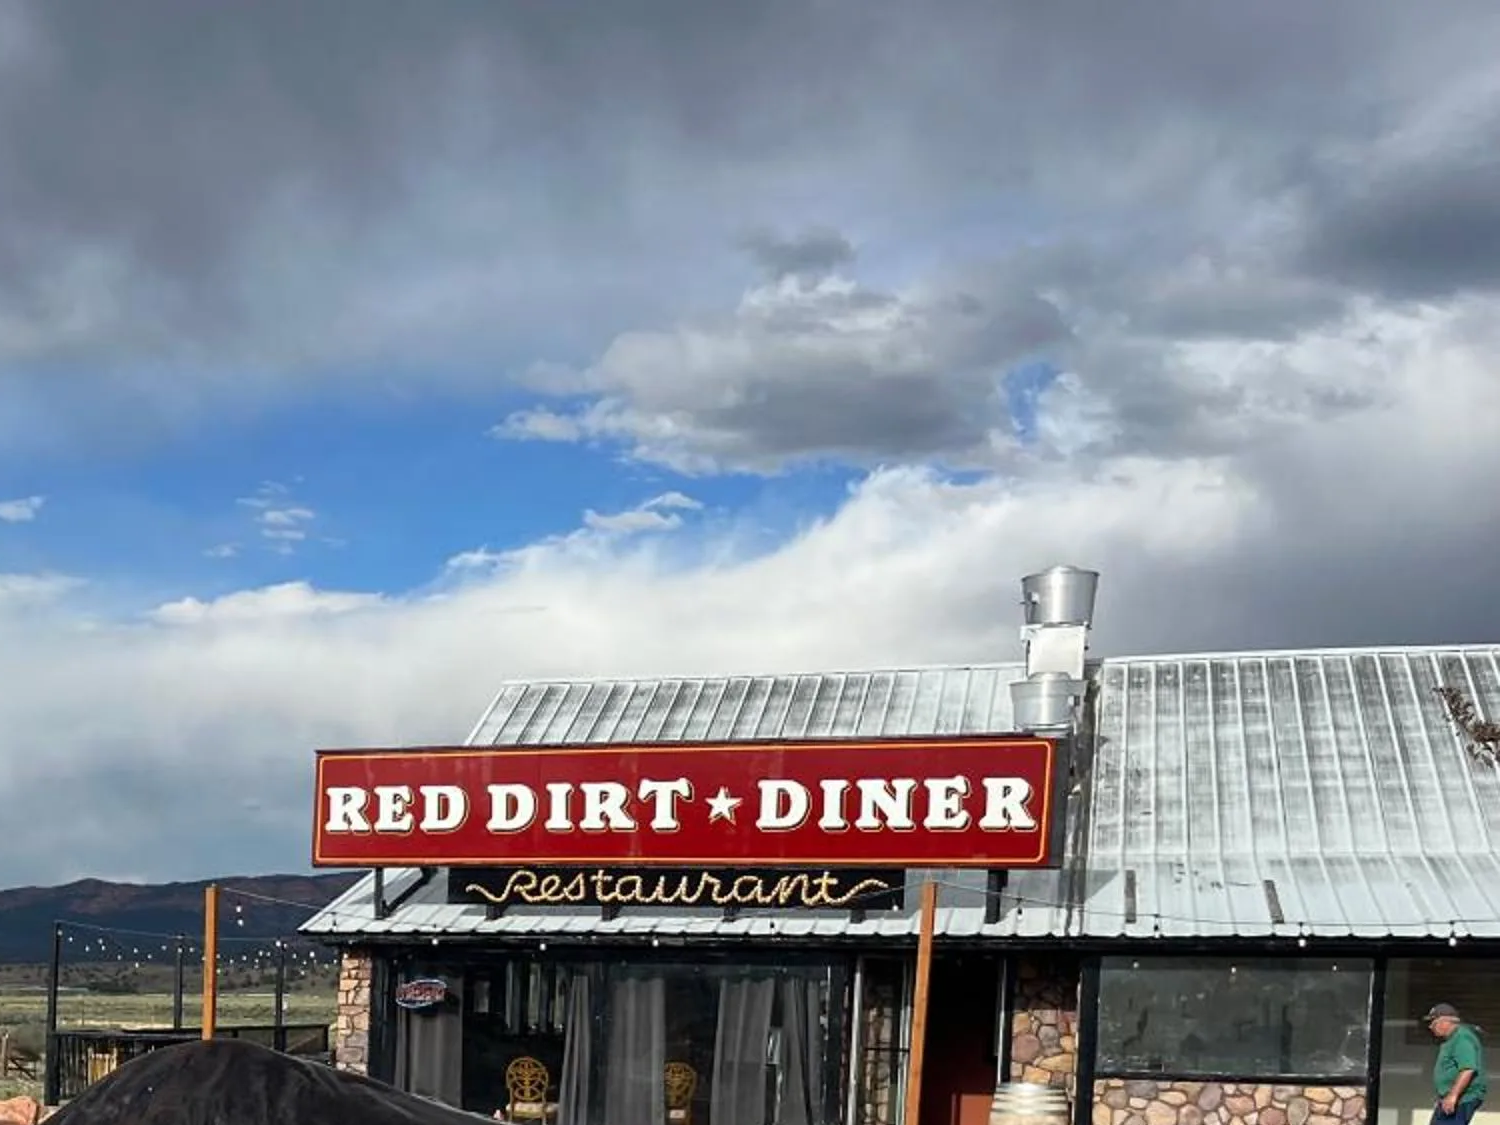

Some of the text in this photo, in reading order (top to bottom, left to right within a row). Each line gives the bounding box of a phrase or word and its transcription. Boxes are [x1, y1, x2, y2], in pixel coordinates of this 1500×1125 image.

[325, 775, 1038, 835] RED DIRT DINER
[466, 869, 888, 904] Restaurant
